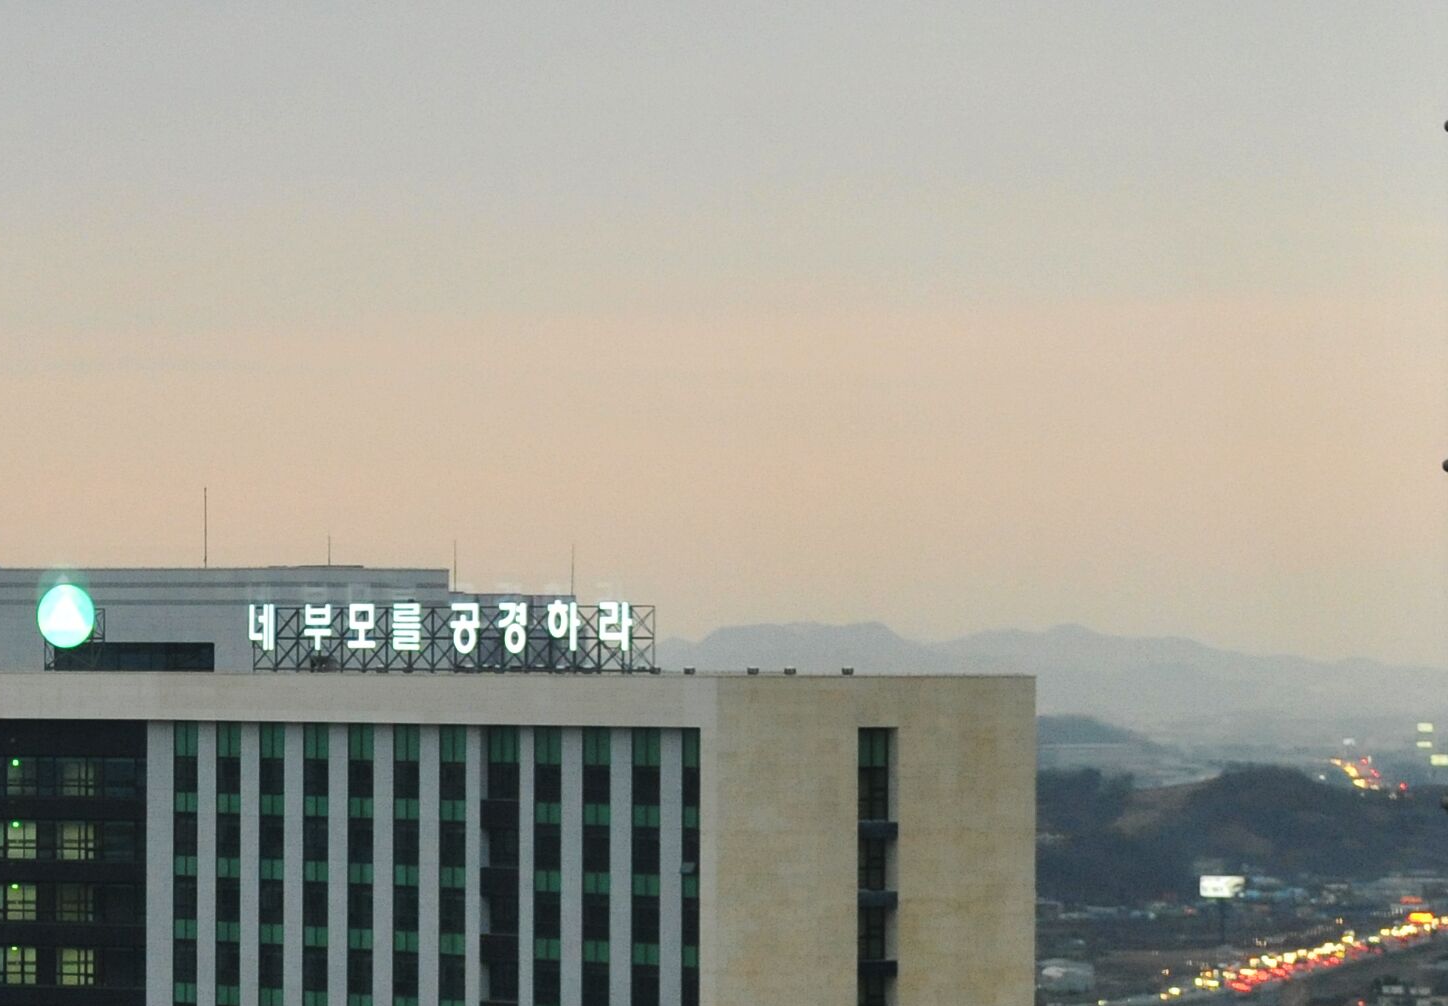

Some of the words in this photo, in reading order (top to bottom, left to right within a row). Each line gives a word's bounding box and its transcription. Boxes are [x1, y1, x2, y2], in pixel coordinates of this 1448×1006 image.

[248, 603, 275, 651] 네
[304, 602, 422, 652] 부모를
[449, 599, 634, 654] 공경하라
